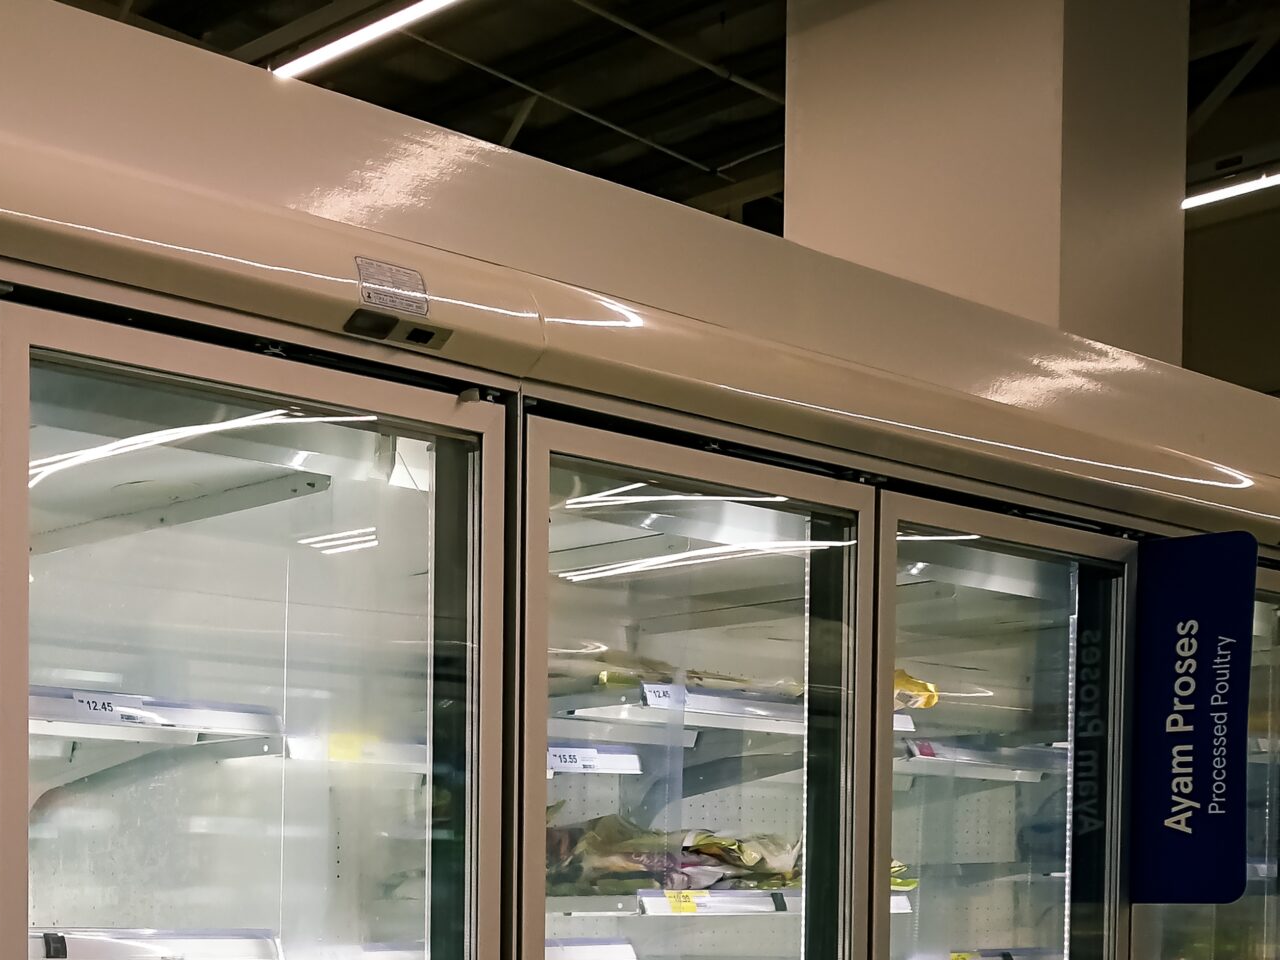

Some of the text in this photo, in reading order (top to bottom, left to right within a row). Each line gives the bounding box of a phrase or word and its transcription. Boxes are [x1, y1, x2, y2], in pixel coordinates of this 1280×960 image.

[86, 700, 114, 712] 12.45
[1164, 619, 1201, 834] Ayam Proses
[1208, 636, 1237, 814] Processed Poultry
